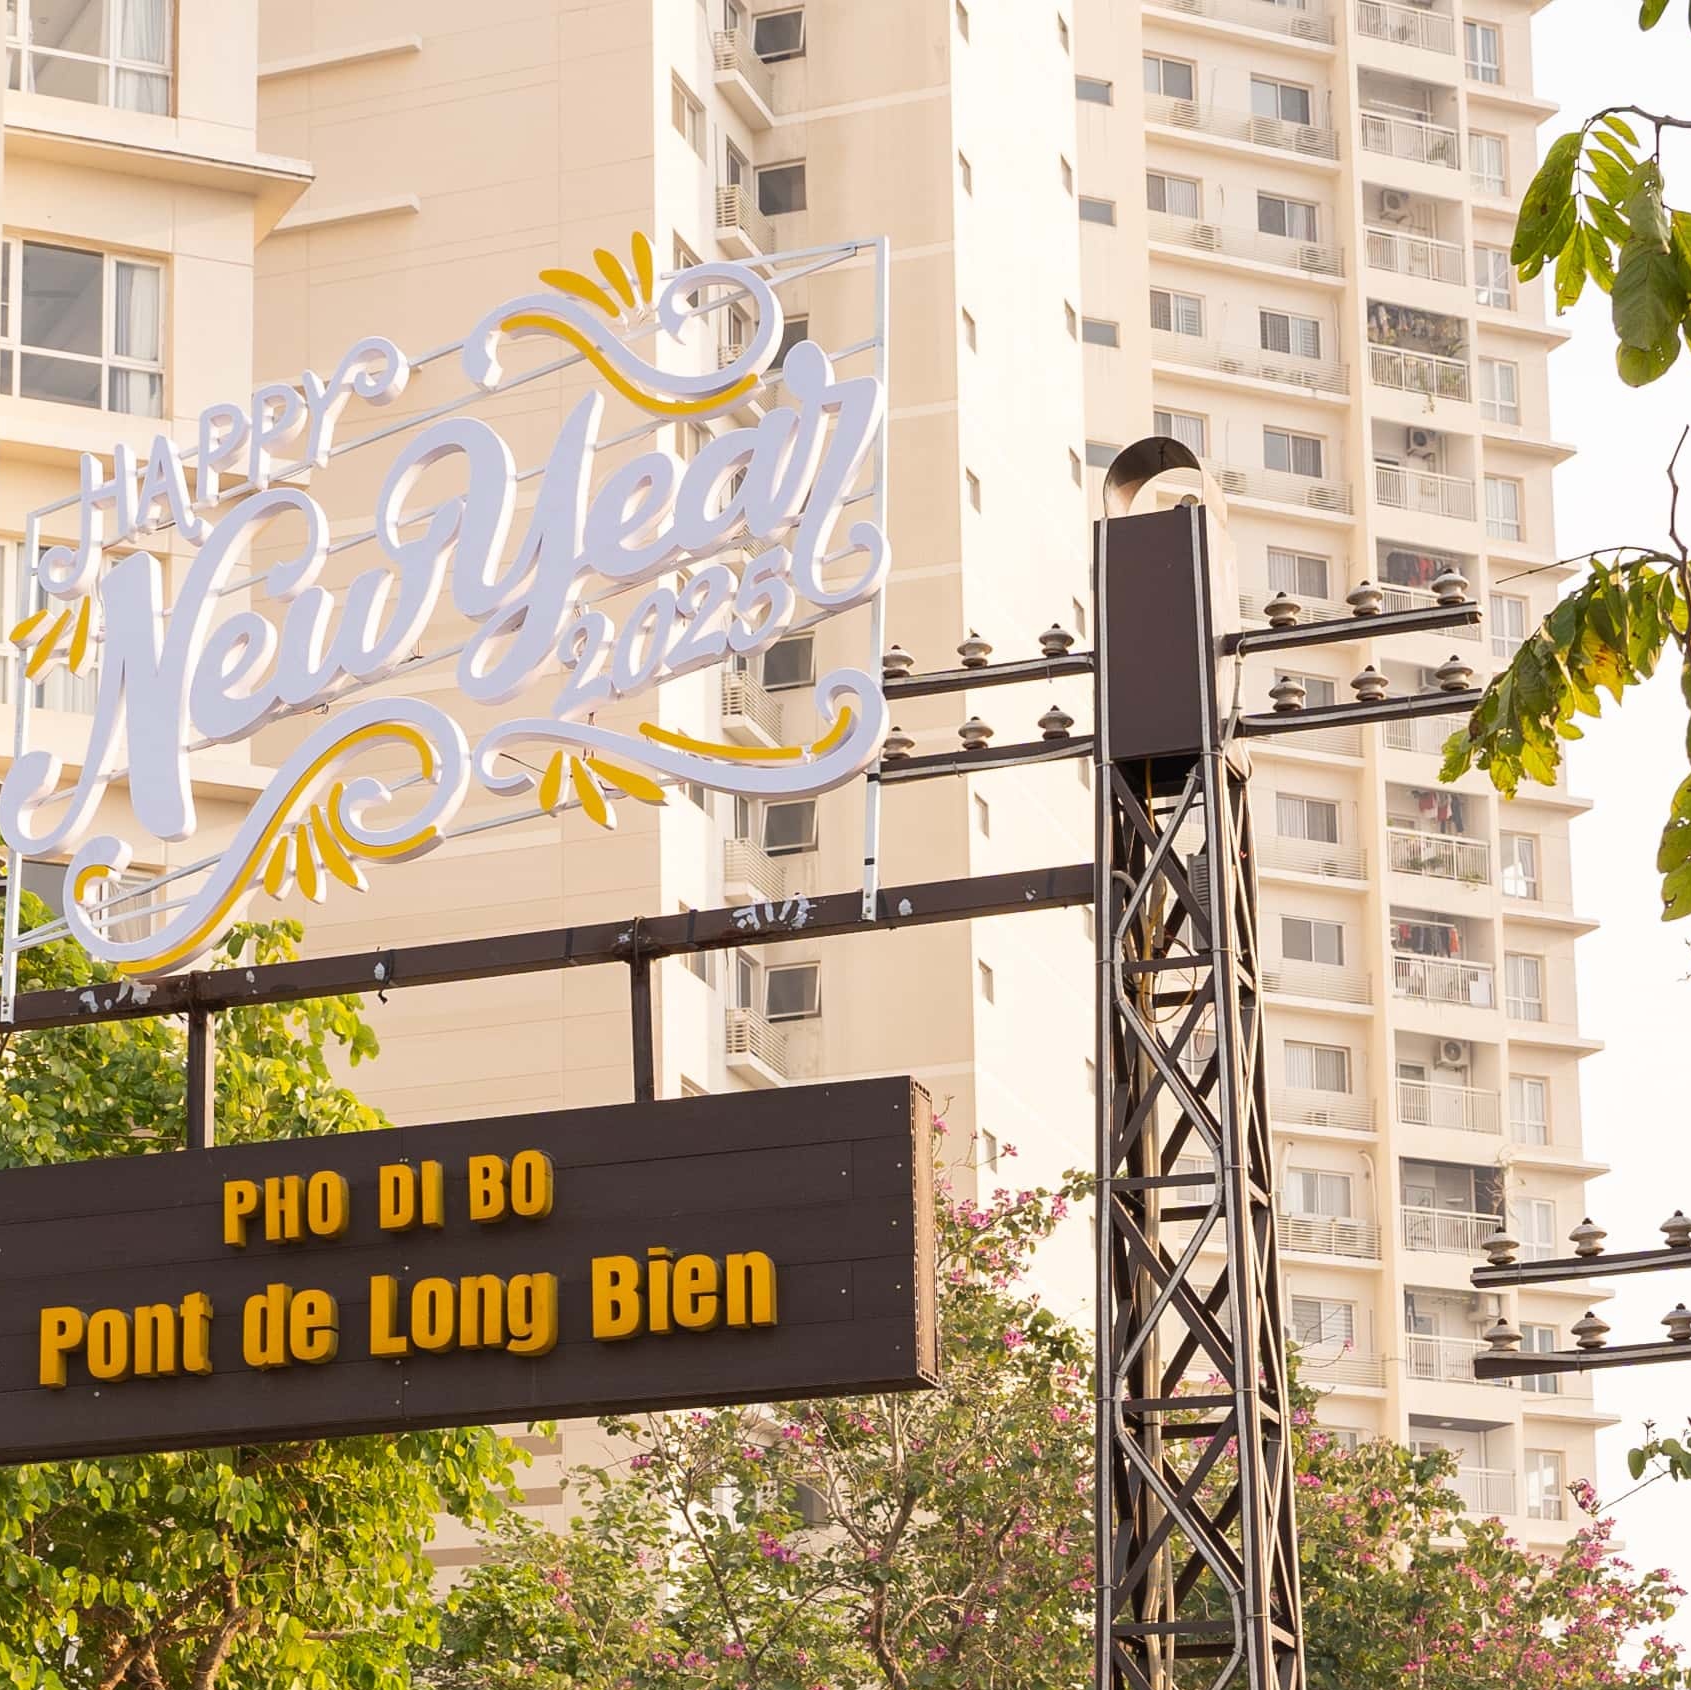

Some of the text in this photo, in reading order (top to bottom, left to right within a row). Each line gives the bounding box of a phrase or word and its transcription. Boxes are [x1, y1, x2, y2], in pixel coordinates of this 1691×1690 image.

[37, 335, 409, 600] HAPPY
[376, 340, 889, 705] Year
[553, 545, 794, 719] 2025
[223, 1149, 553, 1248] PHO DI BO
[39, 1291, 213, 1389] Pont
[242, 1283, 339, 1370] de
[370, 1271, 558, 1359] Long
